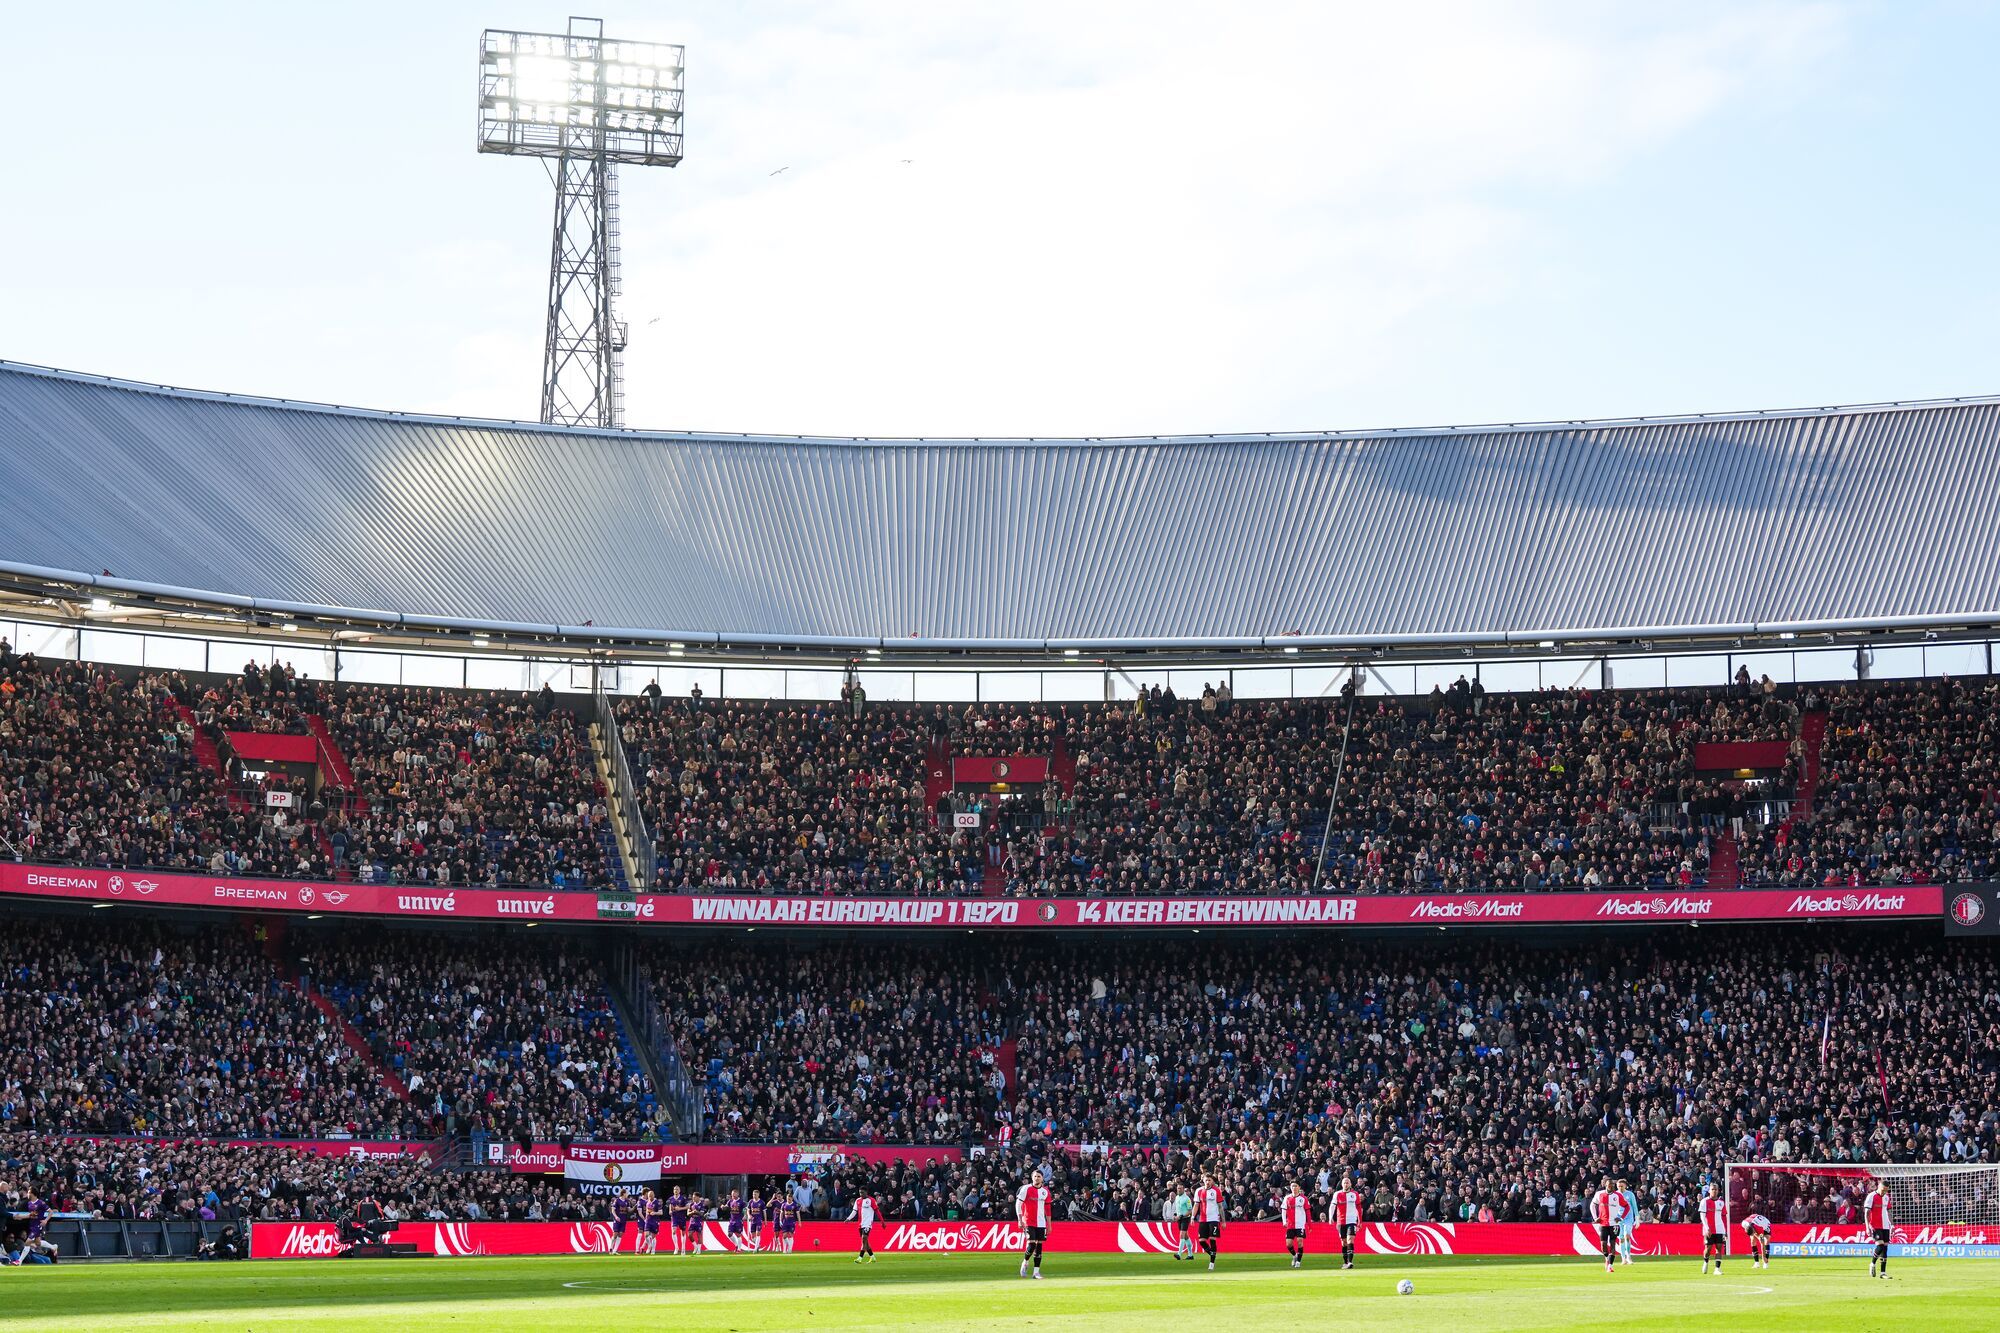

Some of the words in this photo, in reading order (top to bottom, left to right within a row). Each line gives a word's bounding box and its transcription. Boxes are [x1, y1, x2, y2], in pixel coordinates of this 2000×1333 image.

[272, 794, 286, 804] PP
[958, 816, 975, 826] QQ
[27, 874, 97, 889] BREEMAN
[214, 886, 287, 900] BREEMAN
[398, 892, 456, 911] univé
[497, 895, 554, 914] univé
[692, 899, 807, 921] WINNAAR
[808, 900, 944, 923] EUROPACUP
[1077, 901, 1101, 923] 14
[1103, 901, 1164, 922] KEER
[1165, 900, 1357, 922] BEKERWINNAAR
[1410, 901, 1462, 917] Media
[1477, 900, 1523, 916] Markt
[1597, 899, 1650, 915] Media
[1664, 898, 1712, 914] Markt
[1787, 895, 1840, 912] Media
[1856, 894, 1905, 910] Markt
[493, 1146, 500, 1157] P
[571, 1147, 655, 1160] FEYENOORD
[661, 1152, 687, 1168] g.nl
[580, 1183, 644, 1196] VICTORIA
[281, 1226, 334, 1254] Media
[884, 1224, 957, 1250] Media
